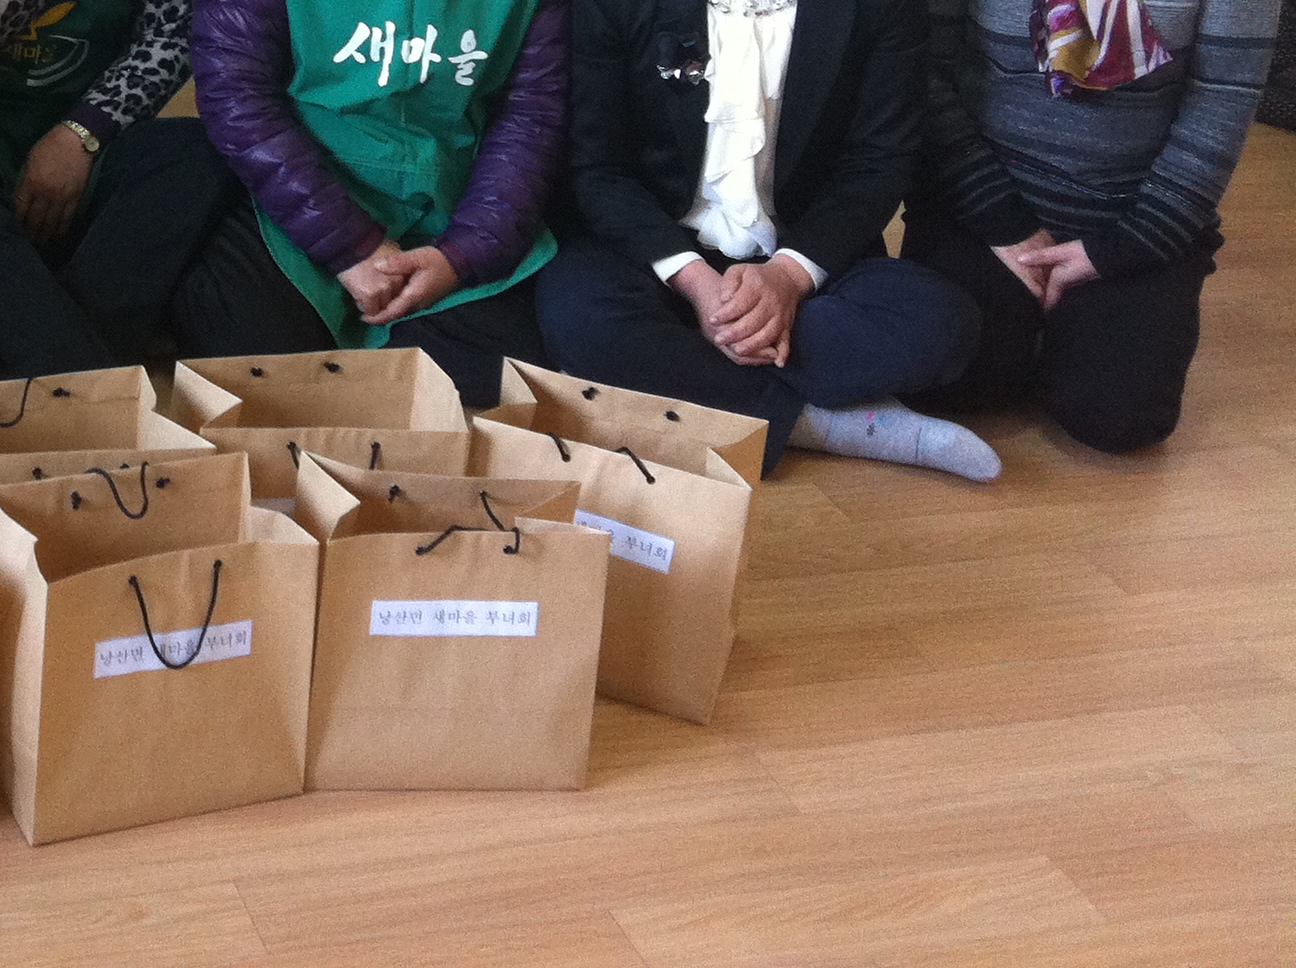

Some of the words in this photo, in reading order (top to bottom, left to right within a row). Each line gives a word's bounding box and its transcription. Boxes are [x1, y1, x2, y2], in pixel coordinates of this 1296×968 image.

[333, 20, 488, 87] 새마을
[432, 609, 478, 625] 새마을
[486, 610, 532, 626] 부녀회
[205, 630, 247, 650] 부녀회
